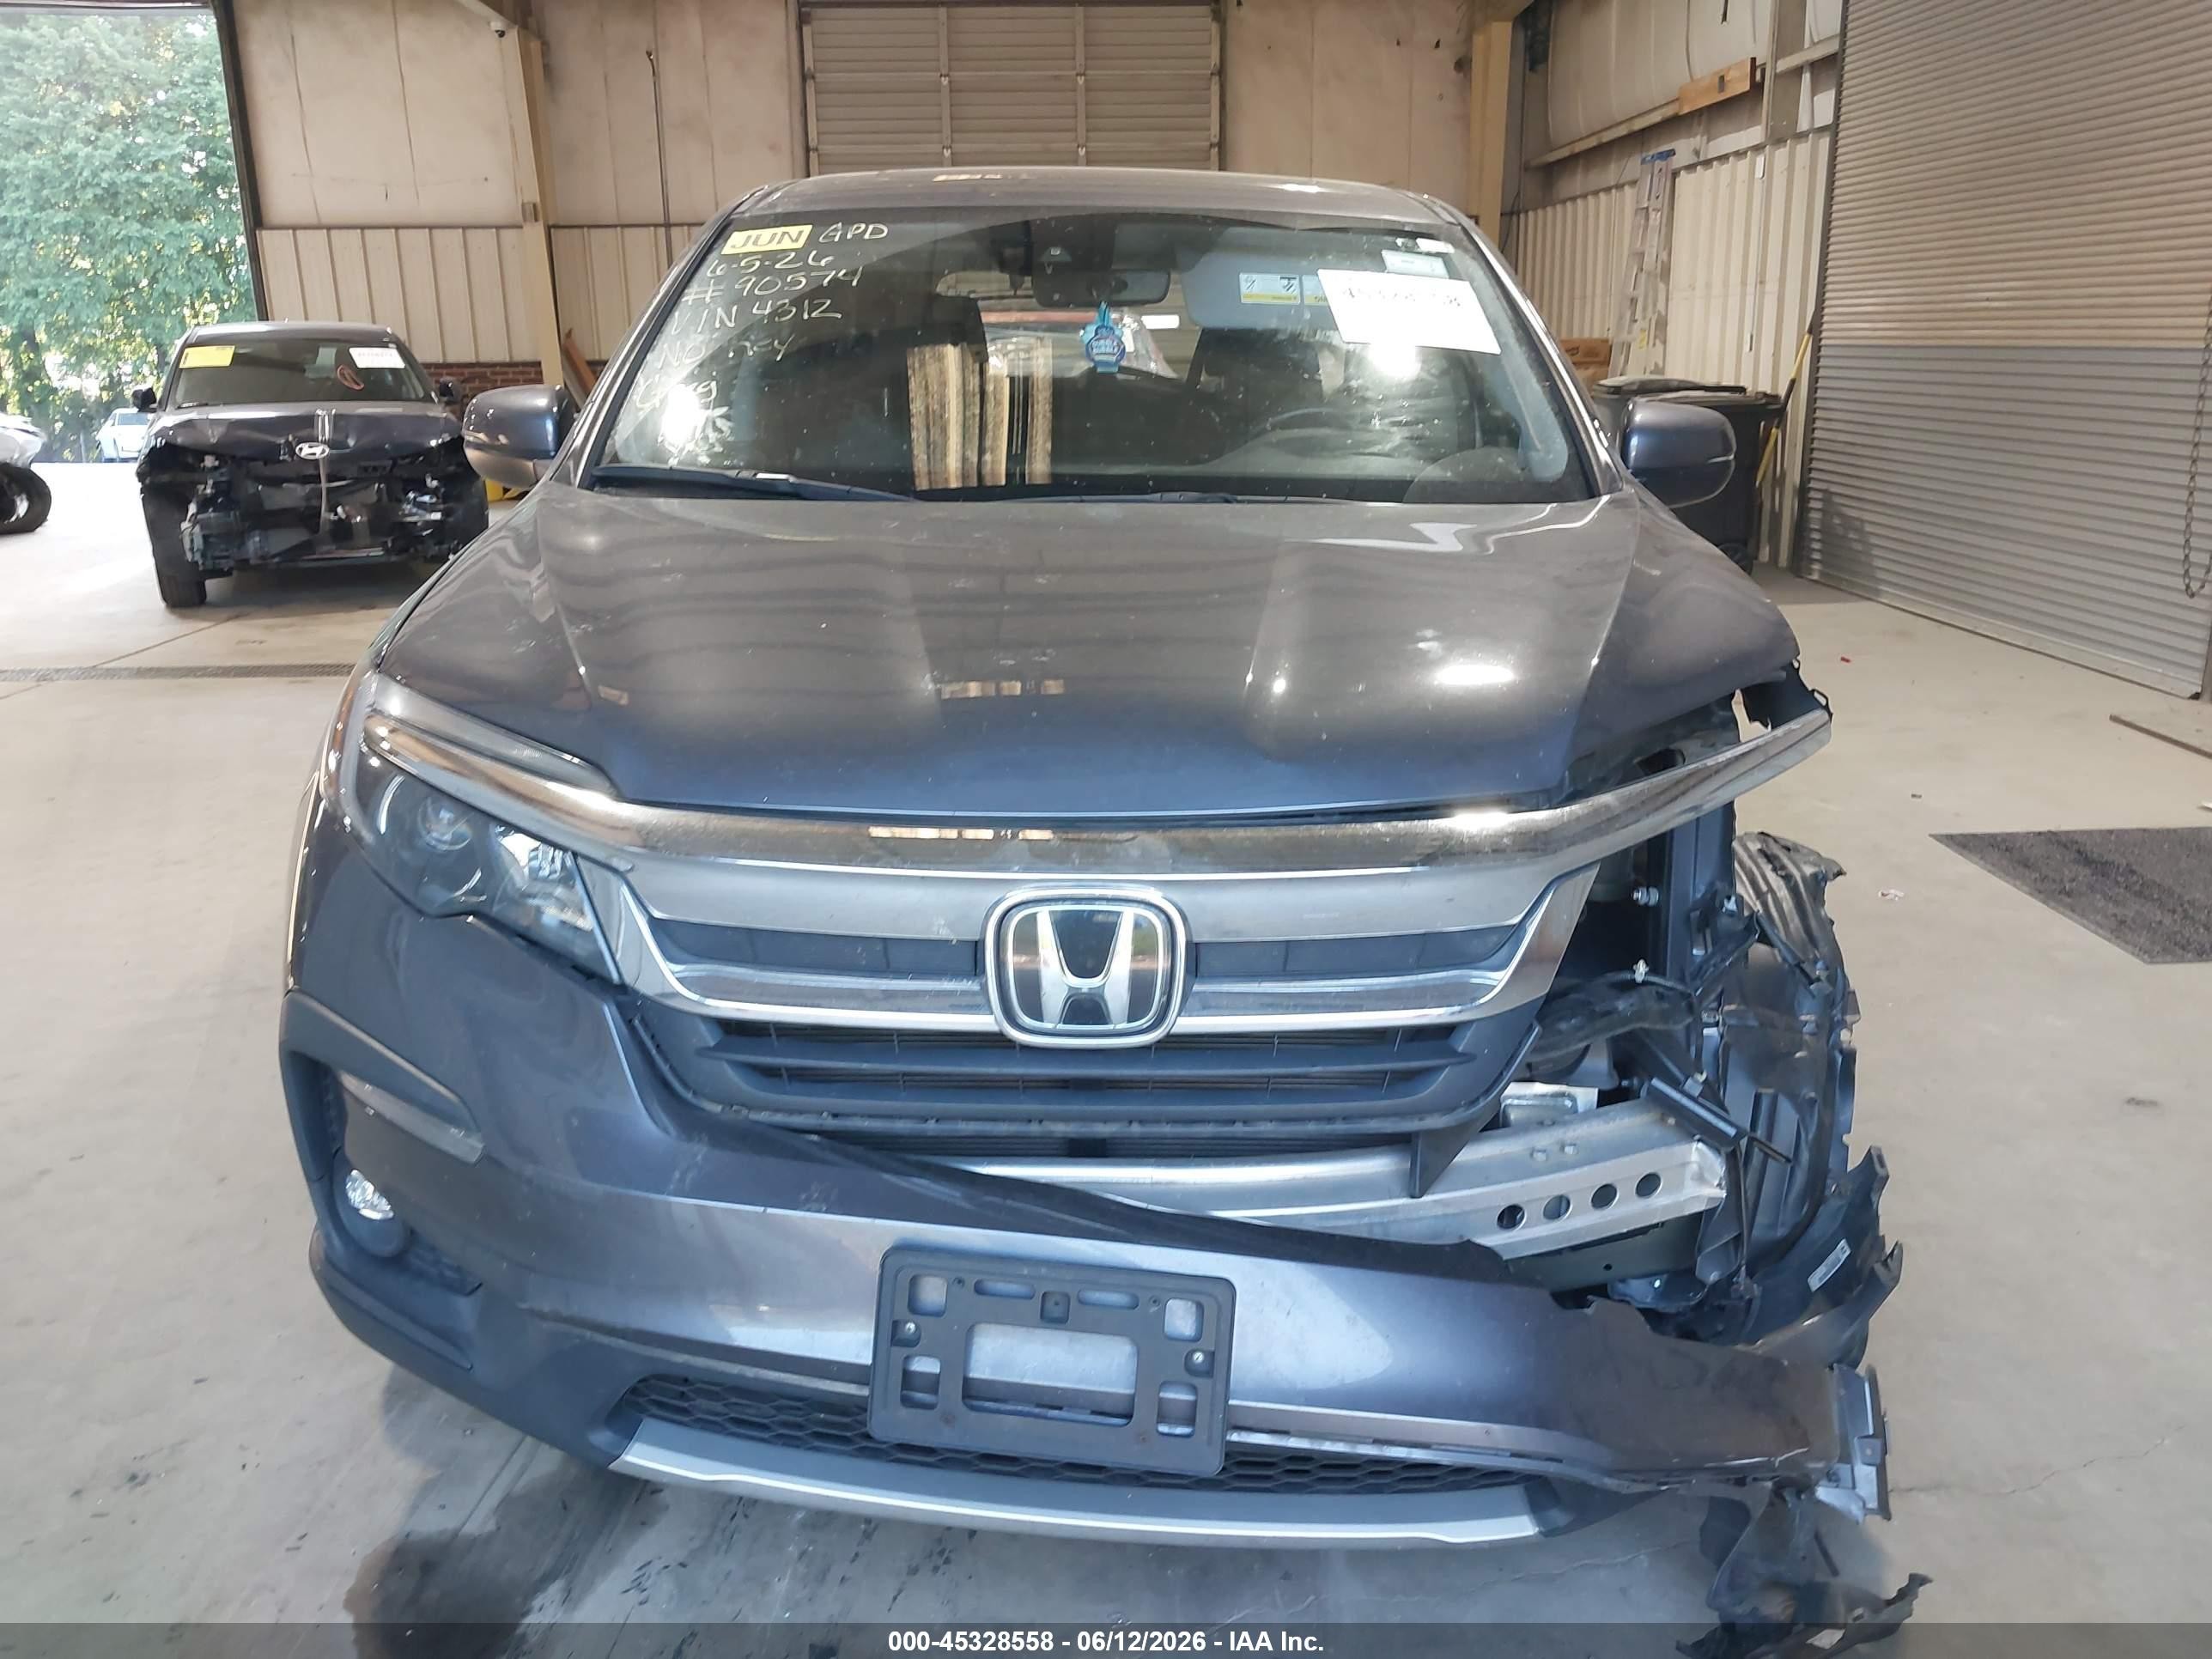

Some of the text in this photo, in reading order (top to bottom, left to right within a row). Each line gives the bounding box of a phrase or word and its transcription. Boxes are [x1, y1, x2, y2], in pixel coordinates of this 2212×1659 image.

[729, 228, 805, 250] JUN
[734, 265, 863, 297] 90574
[671, 298, 842, 334] VIN 4312
